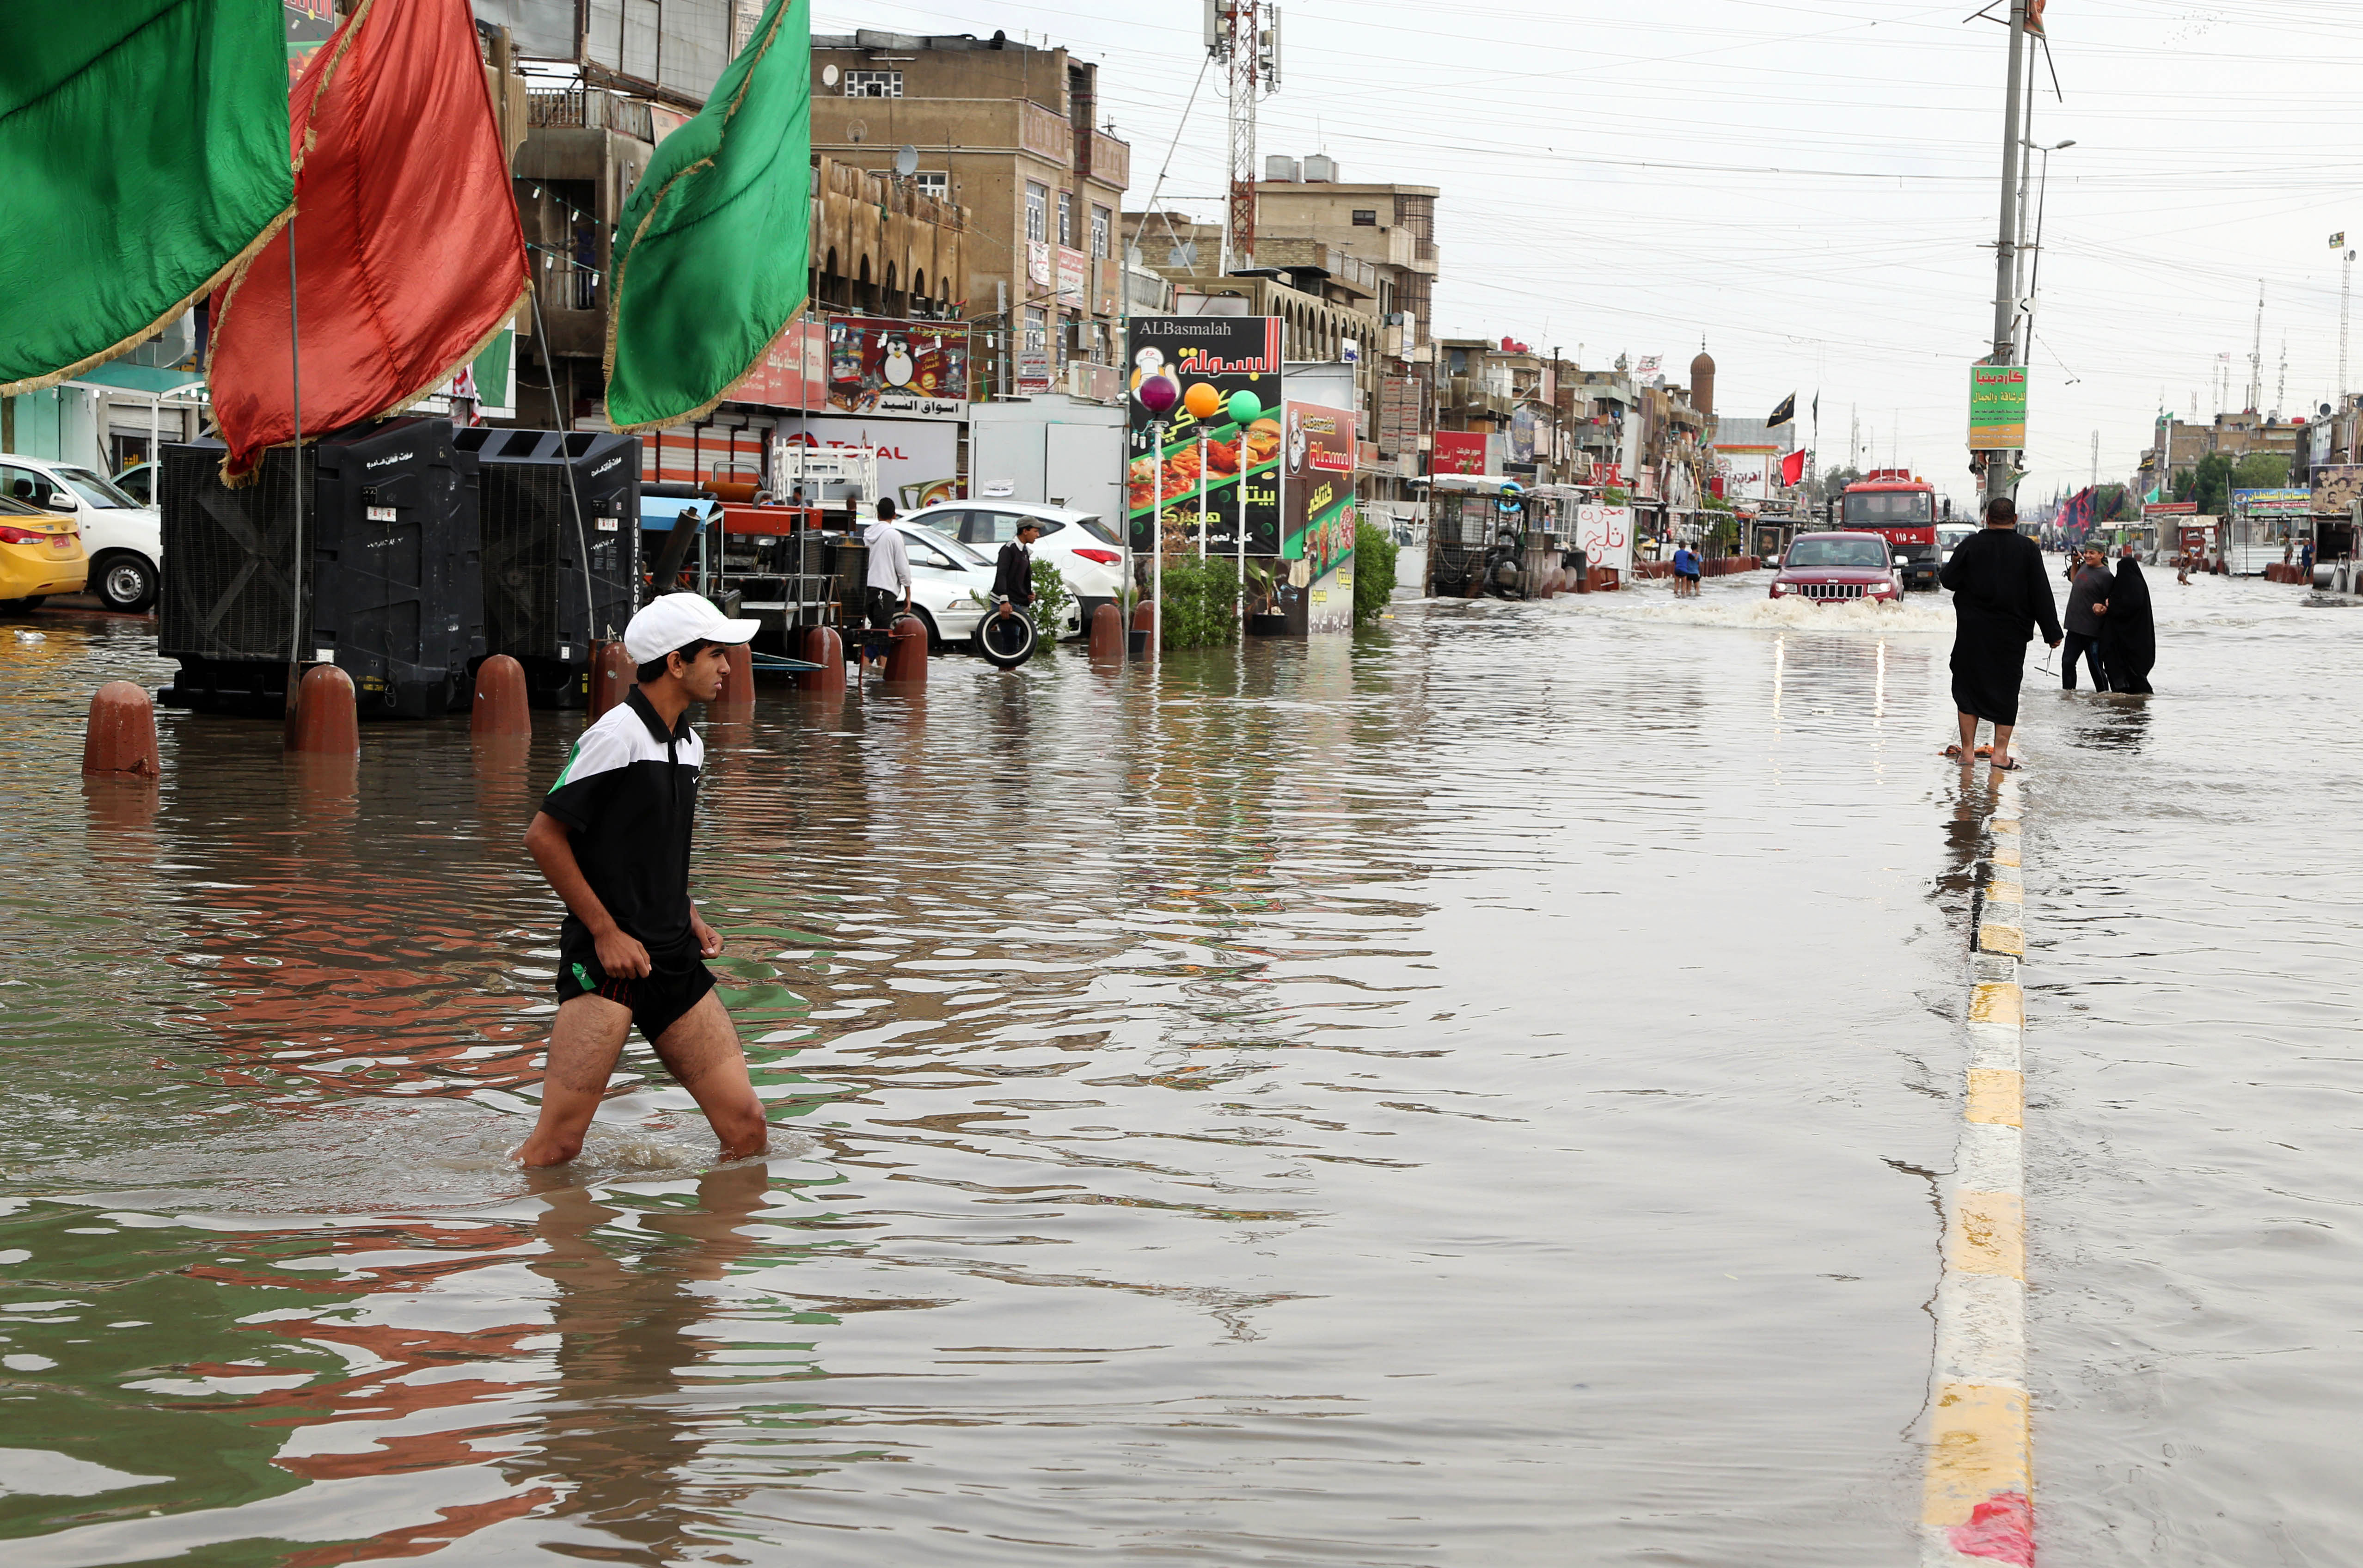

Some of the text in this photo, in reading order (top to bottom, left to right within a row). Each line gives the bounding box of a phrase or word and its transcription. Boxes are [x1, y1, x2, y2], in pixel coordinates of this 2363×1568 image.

[1139, 321, 1231, 335] ALBasmalah
[1179, 318, 1280, 381] البسملة
[881, 400, 958, 414] اسواق السيد
[1973, 392, 2026, 404] للرشاقة والجمال
[1310, 418, 1354, 481] البسملة
[1581, 506, 1624, 524] مخزن
[1586, 521, 1624, 564] ثلج
